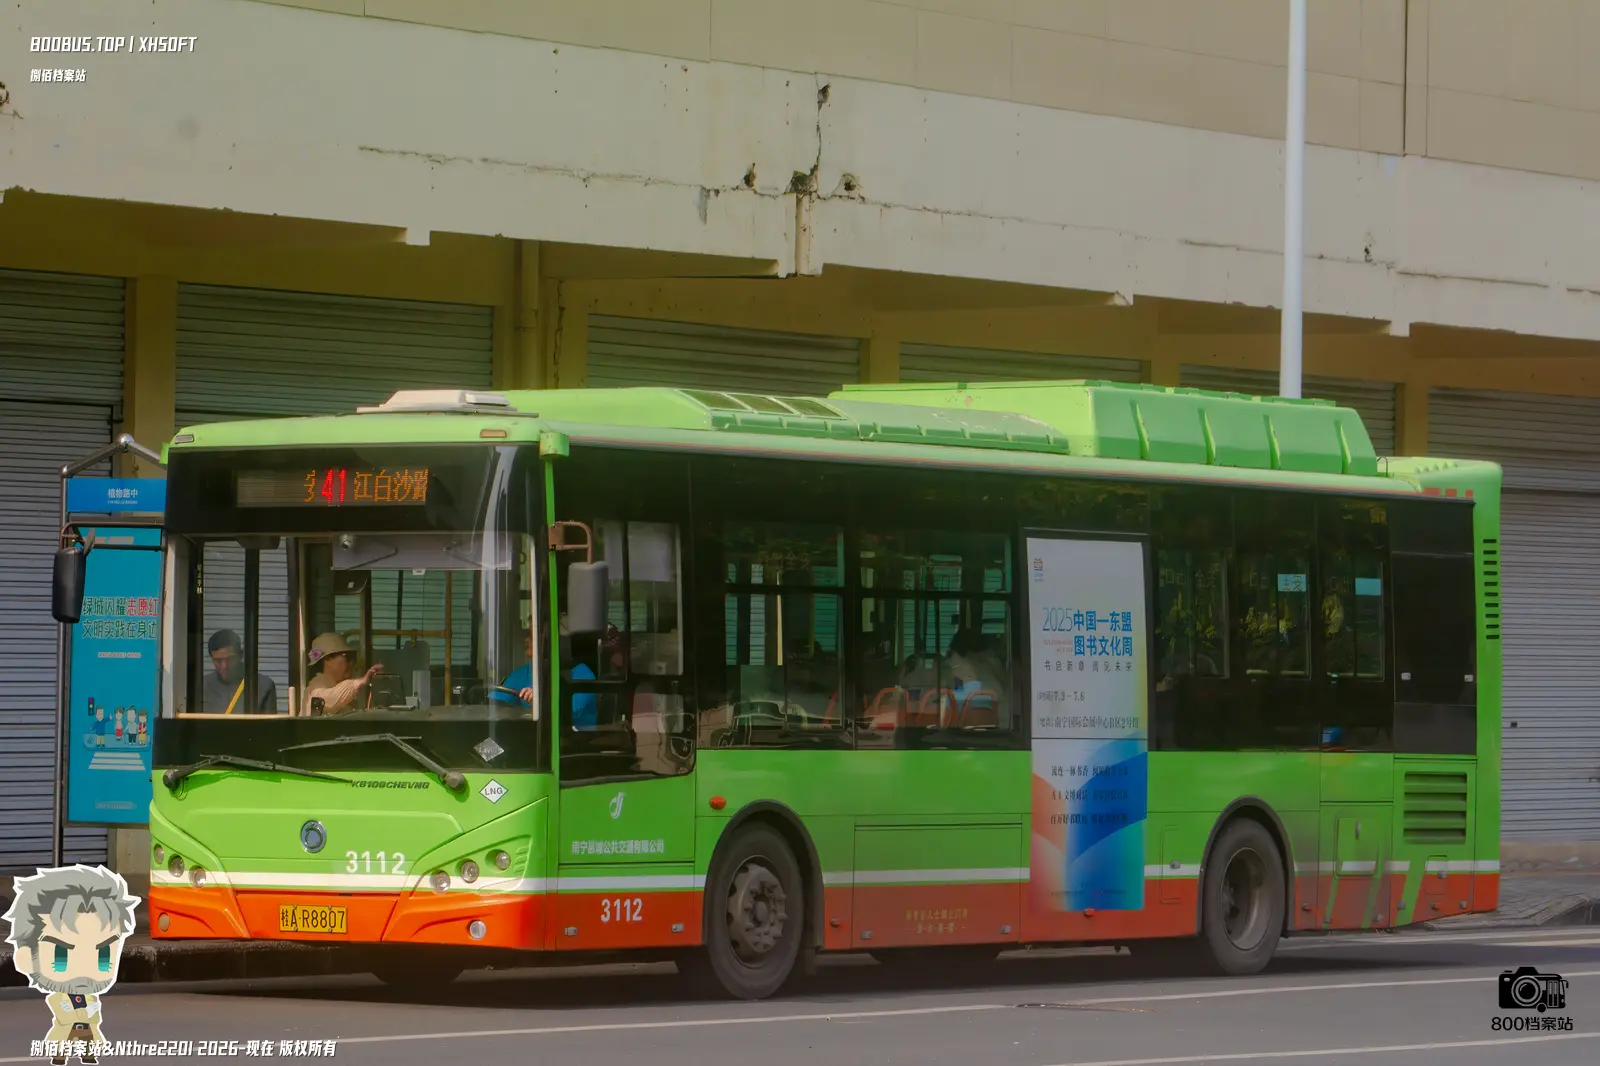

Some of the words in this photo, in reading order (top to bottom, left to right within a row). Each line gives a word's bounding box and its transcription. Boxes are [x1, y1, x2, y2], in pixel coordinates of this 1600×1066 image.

[321, 468, 347, 502] 41
[82, 596, 160, 617] 绿城闪耀志愿红
[1073, 636, 1133, 657] 图书文化周
[484, 787, 503, 796] LNG
[345, 850, 406, 875] 3112
[600, 897, 643, 923] 3112
